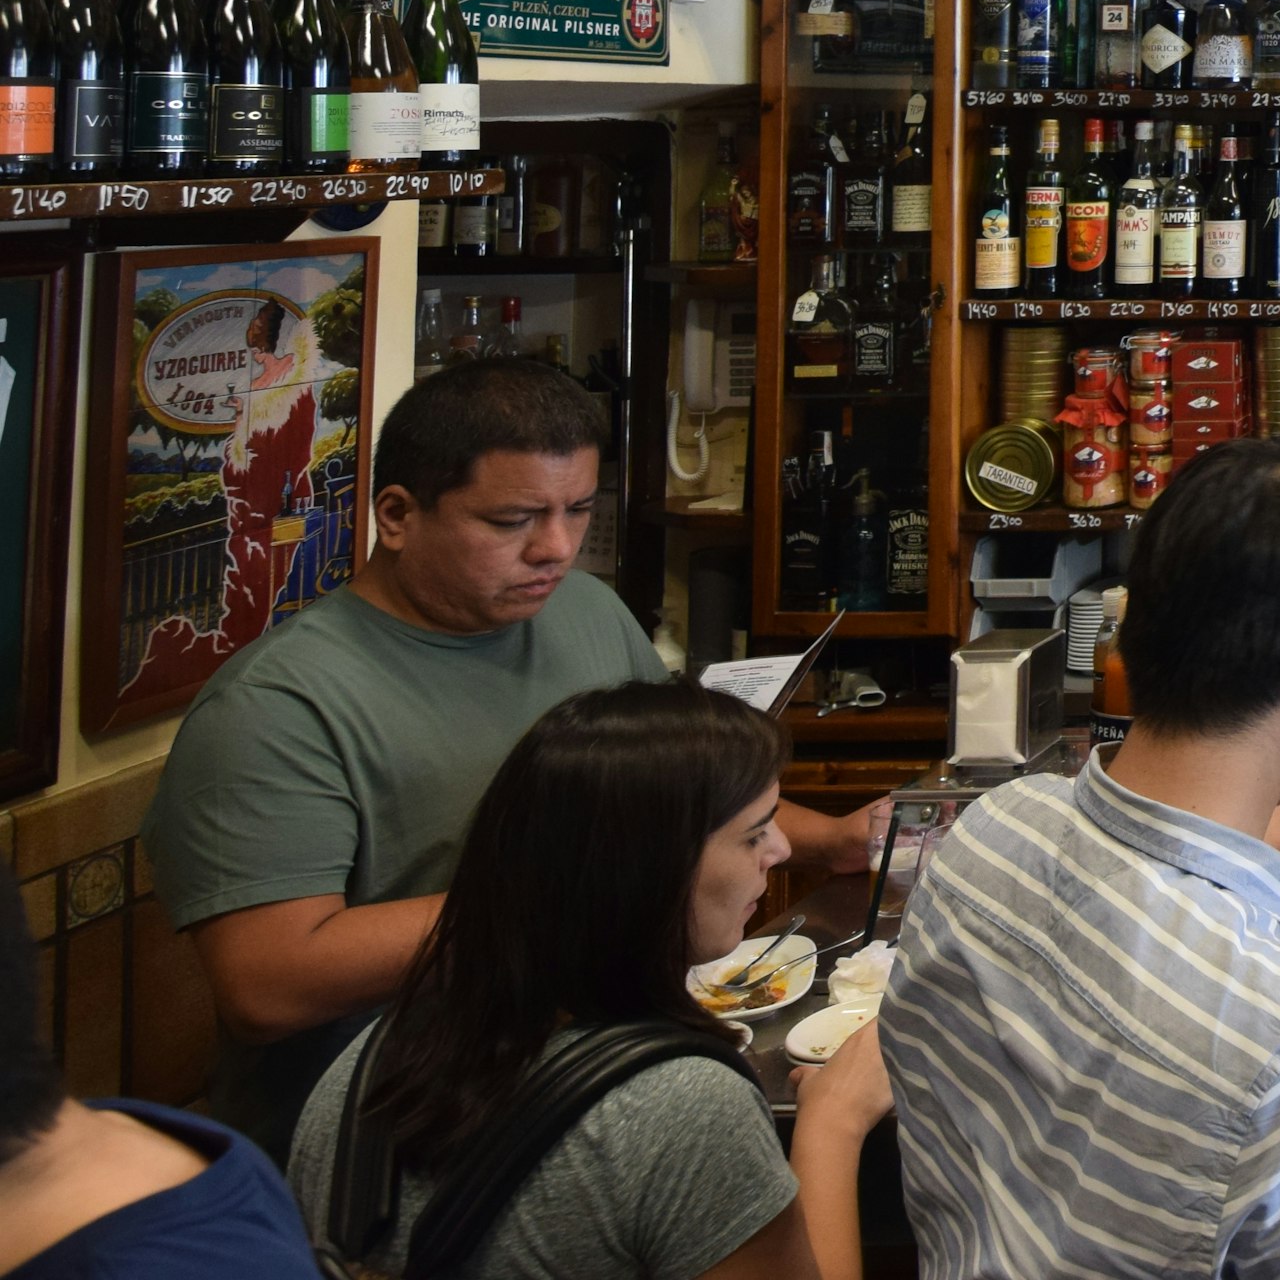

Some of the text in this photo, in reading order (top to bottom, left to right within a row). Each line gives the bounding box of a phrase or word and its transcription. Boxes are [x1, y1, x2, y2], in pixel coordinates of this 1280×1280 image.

[554, 6, 590, 18] CZECH
[1107, 12, 1124, 24] 24
[488, 14, 621, 37] ORIGINAL PILSNER
[1200, 57, 1247, 68] GIN MARE
[424, 108, 464, 119] Rimarts
[387, 174, 430, 197] 22'90
[448, 173, 484, 192] 10'10
[1161, 304, 1193, 317] 13'60
[164, 307, 244, 348] VERMOUTH
[155, 349, 247, 380] YZAGUIRRE
[985, 464, 1034, 493] TARANTELO
